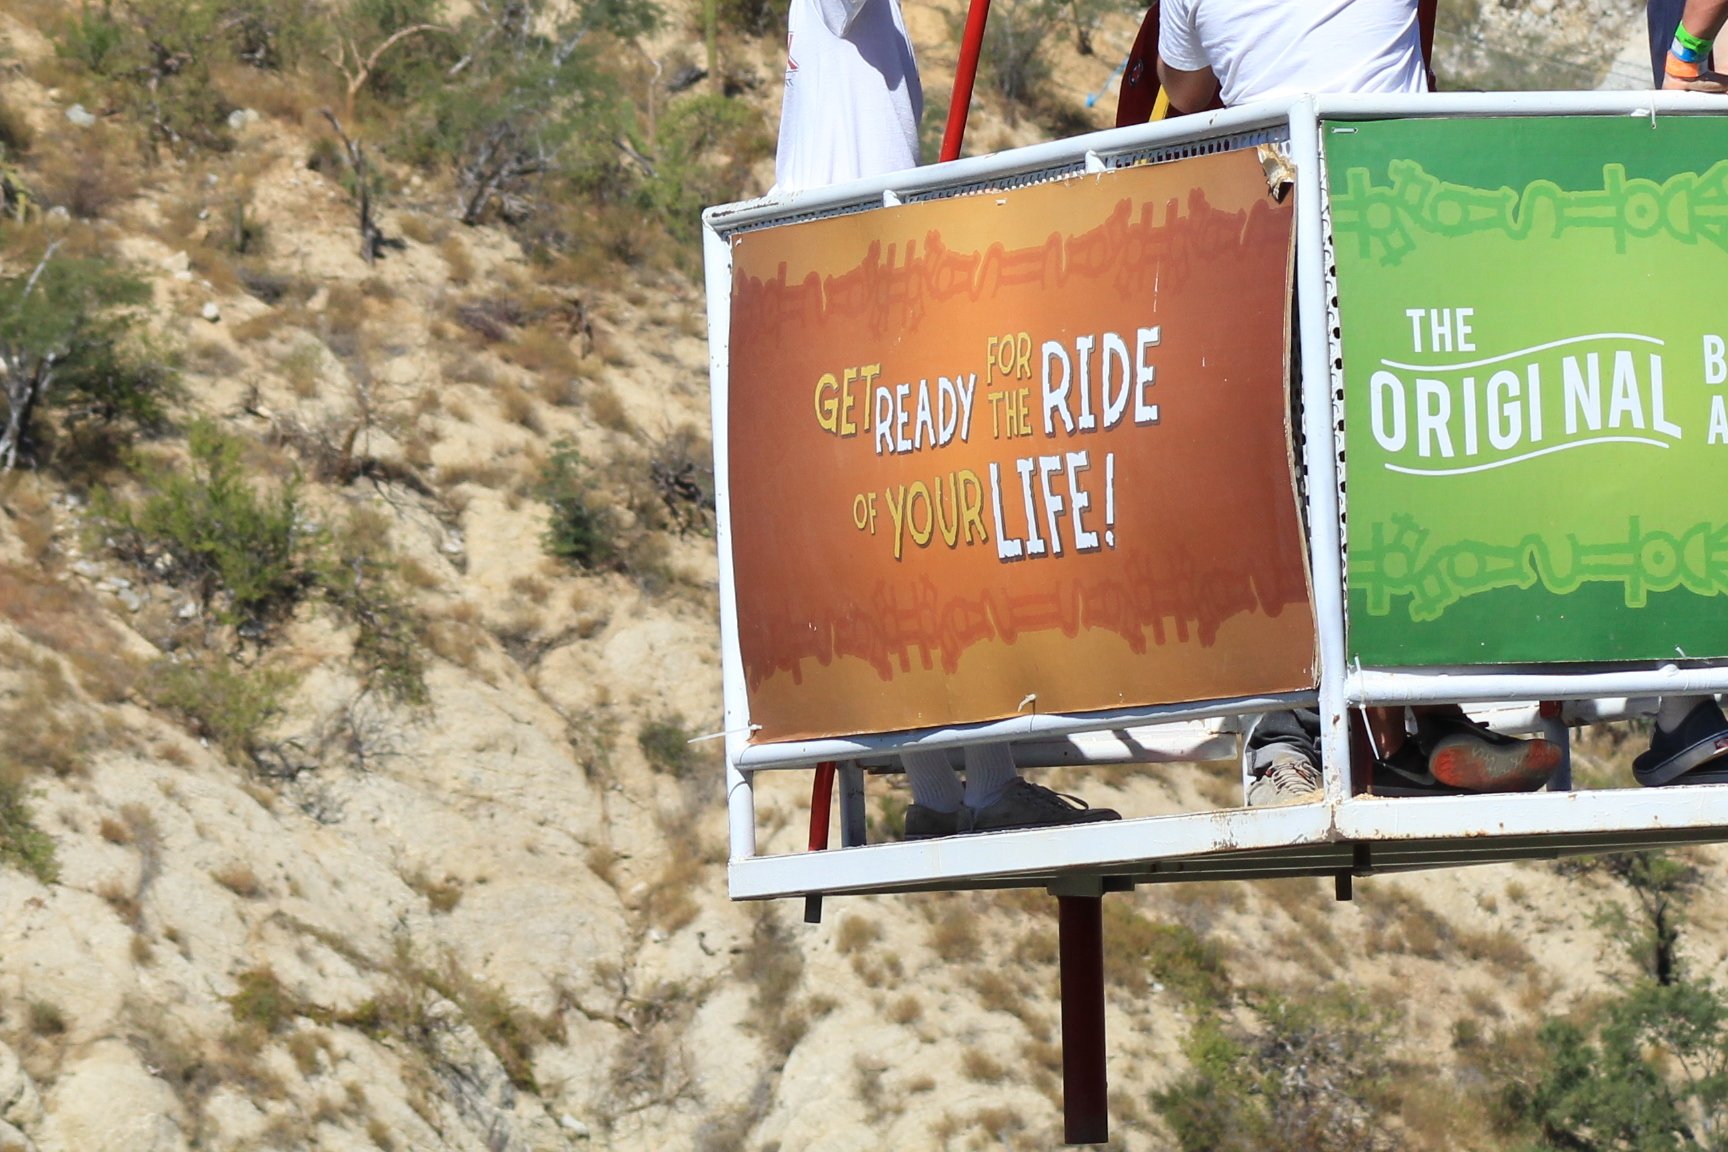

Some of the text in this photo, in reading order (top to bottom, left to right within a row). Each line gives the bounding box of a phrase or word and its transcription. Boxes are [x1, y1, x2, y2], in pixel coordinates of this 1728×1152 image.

[1406, 307, 1476, 353] THE
[814, 326, 1161, 454] GET READY FOR THE RIDE
[853, 450, 1115, 560] OF YOUR LIFE!
